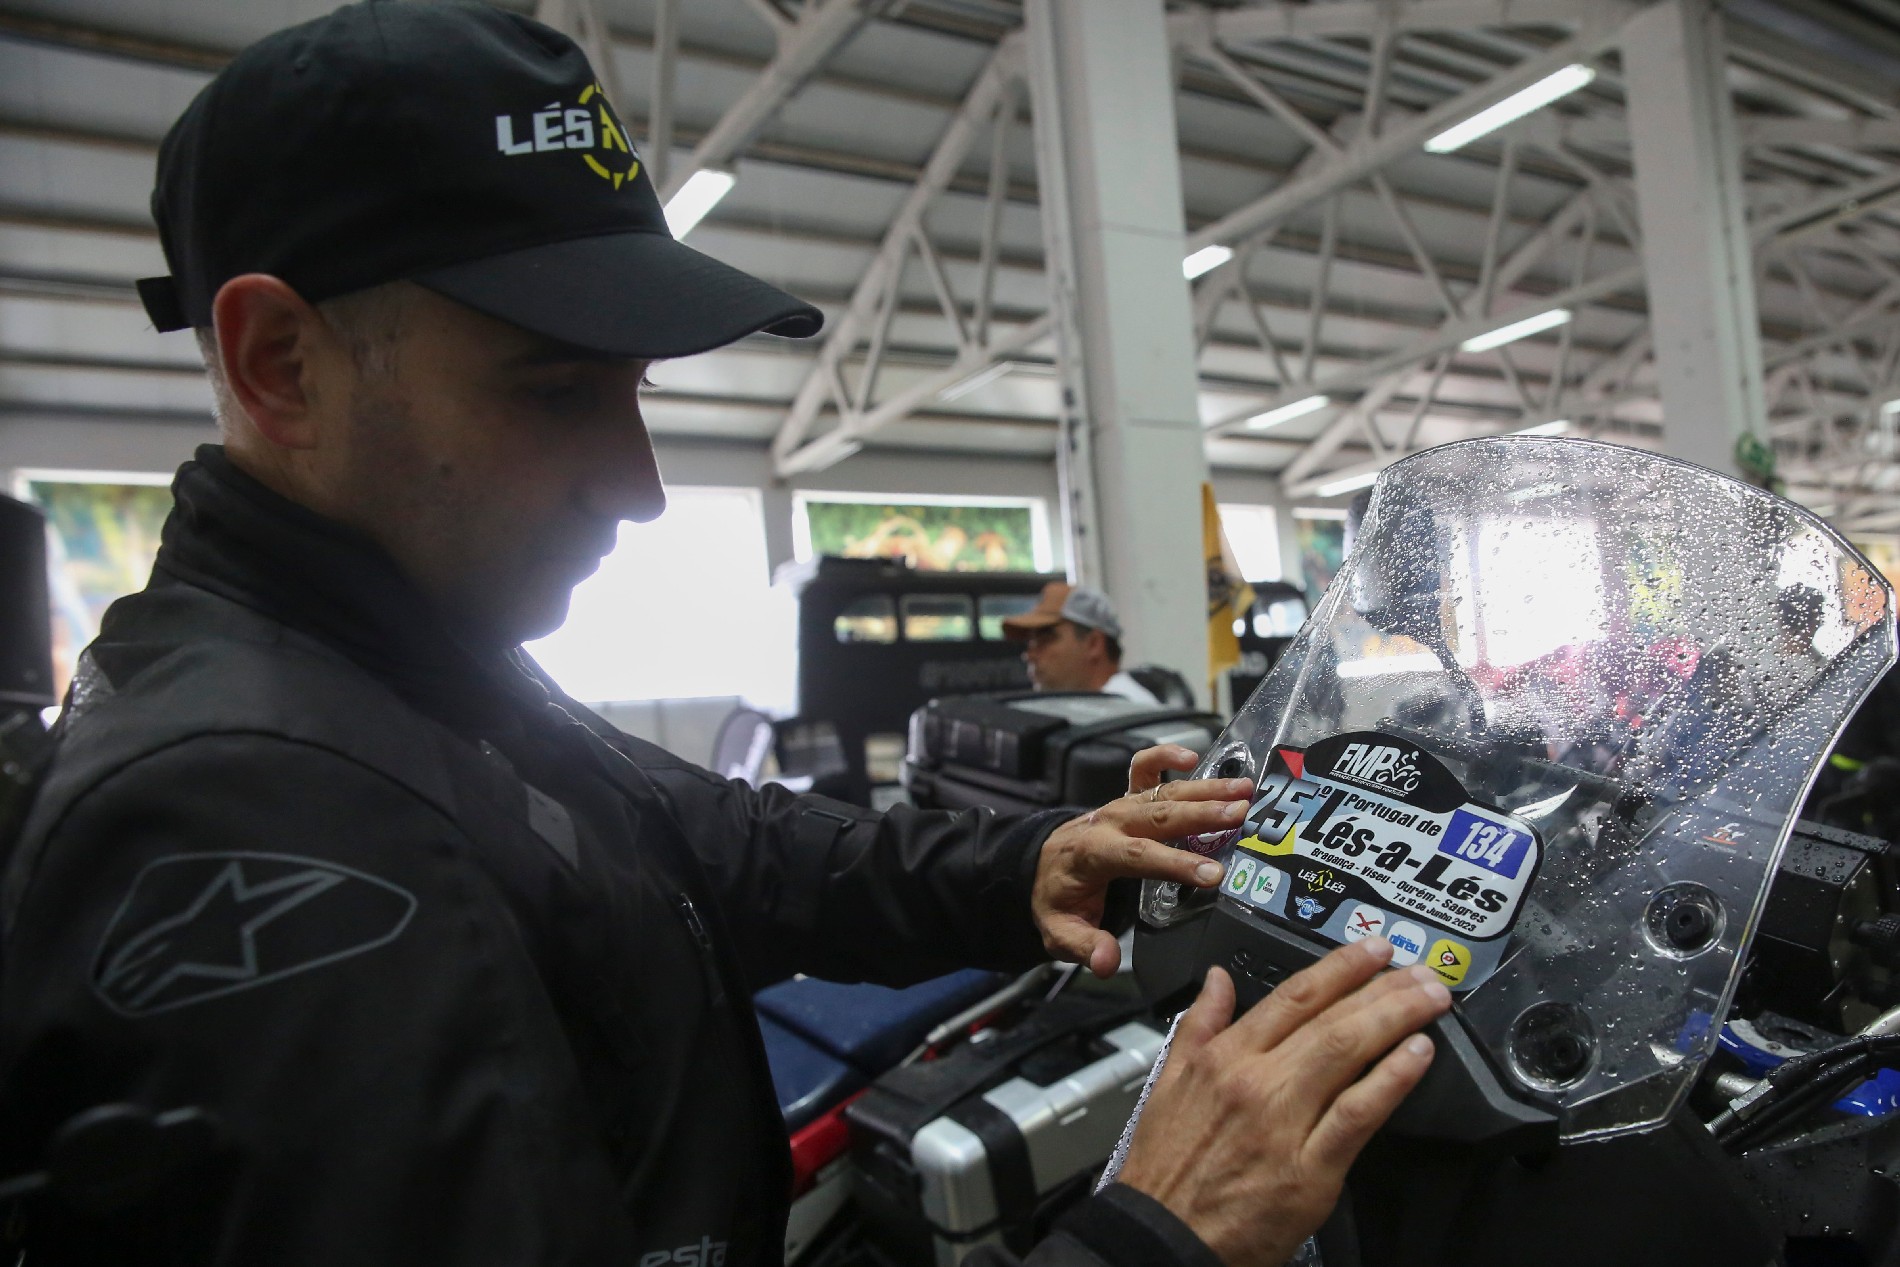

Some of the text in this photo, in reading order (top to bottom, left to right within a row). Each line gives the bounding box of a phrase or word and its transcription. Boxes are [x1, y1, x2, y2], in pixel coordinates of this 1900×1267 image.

[496, 101, 595, 156] LÉS
[1333, 743, 1401, 780] FMP
[1343, 794, 1442, 837] Portugal de
[1299, 788, 1508, 914] Lés-a-Lés
[1456, 821, 1517, 868] 134
[1297, 868, 1316, 883] LÉS
[1324, 881, 1346, 894] LÉS
[1310, 847, 1356, 871] Bragança
[1361, 865, 1391, 885] Viseu
[1396, 880, 1436, 902] Ourém
[1441, 898, 1488, 924] Sagres
[1405, 896, 1415, 907] 10
[1415, 900, 1426, 911] de
[1426, 905, 1452, 923] Junho
[1453, 917, 1477, 933] 2023
